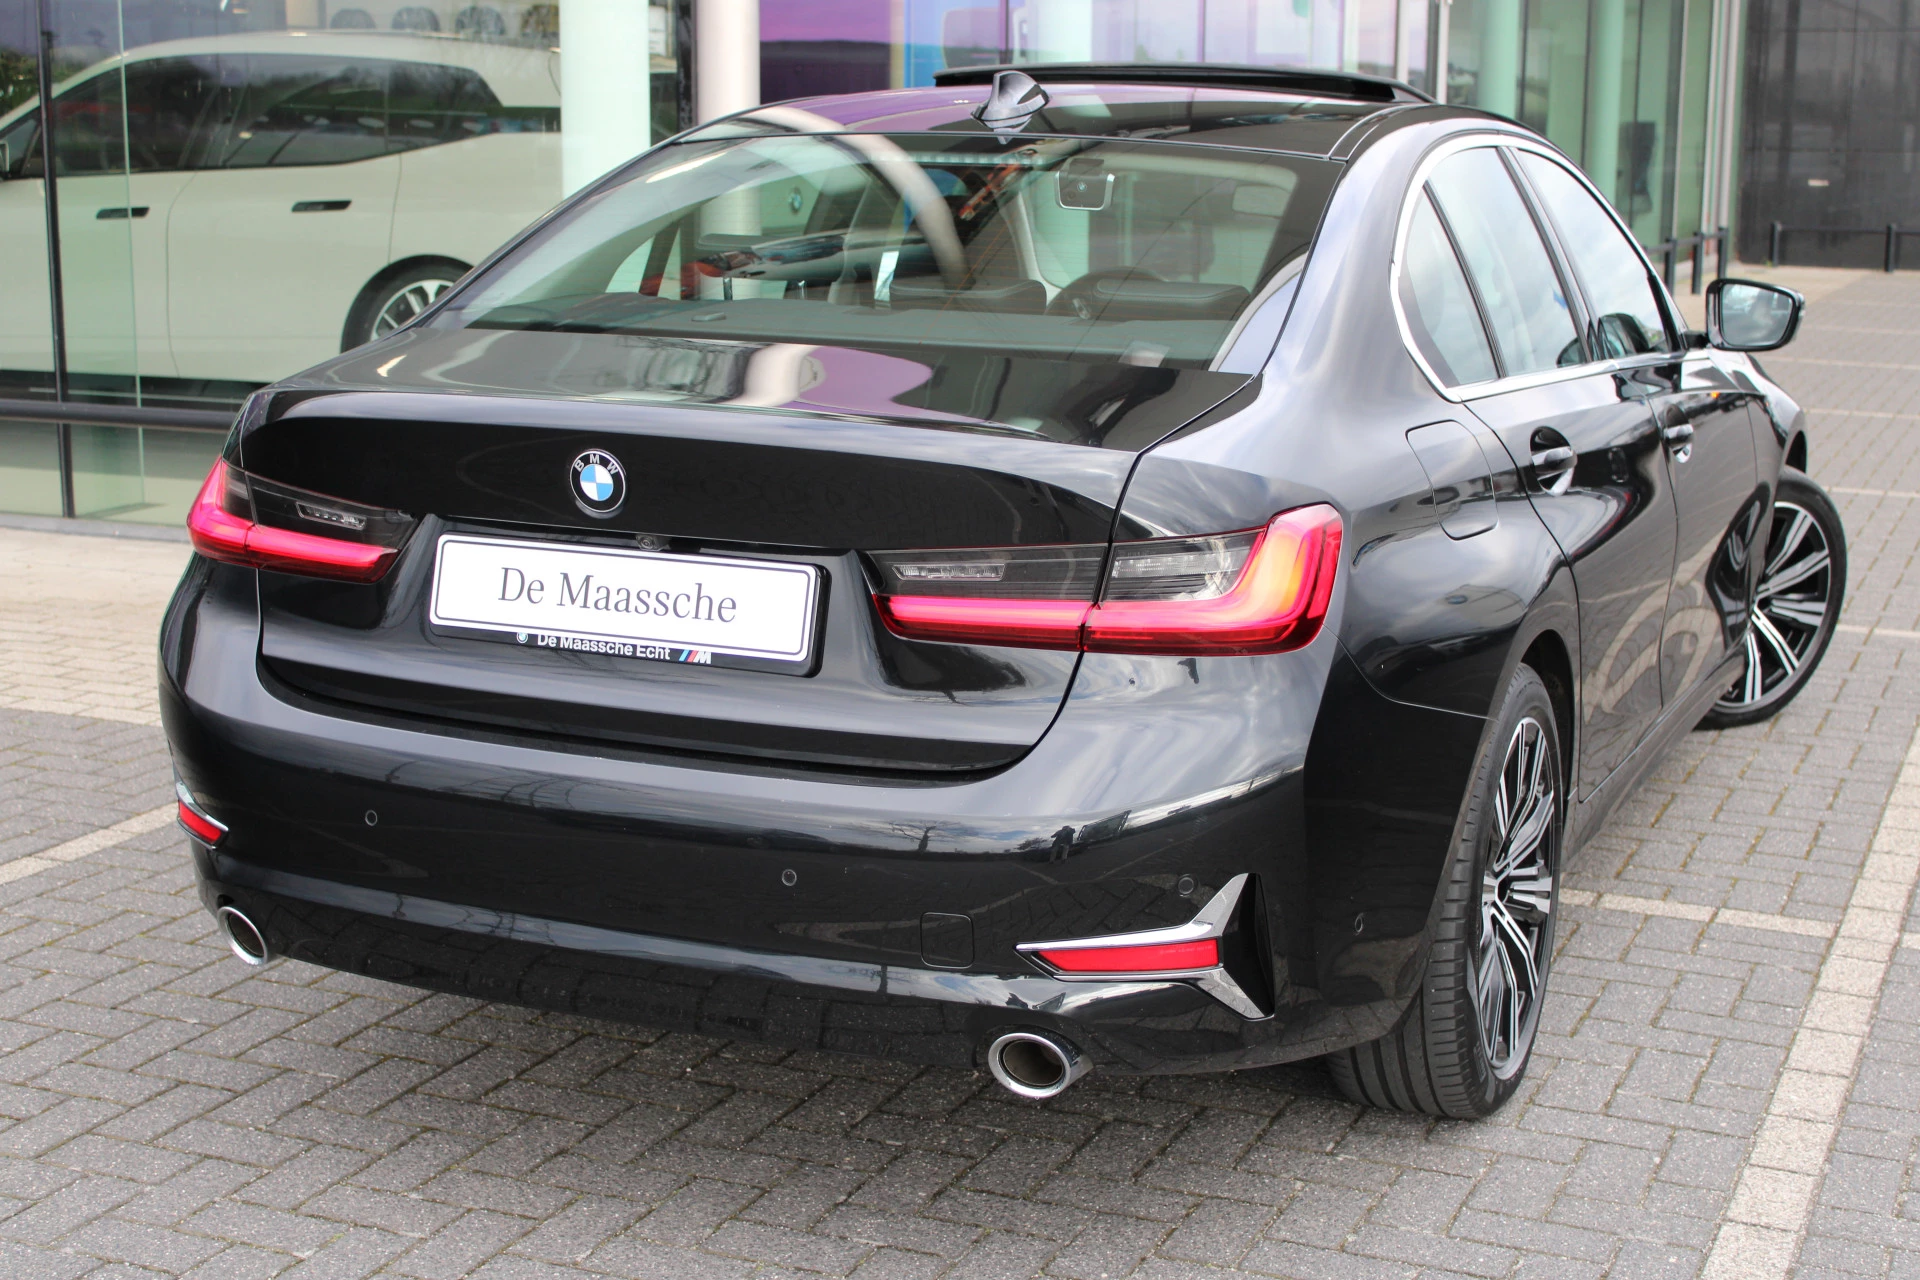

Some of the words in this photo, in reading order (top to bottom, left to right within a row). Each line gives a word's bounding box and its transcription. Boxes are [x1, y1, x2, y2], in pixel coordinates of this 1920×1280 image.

[573, 453, 619, 475] BMW
[497, 566, 545, 604] De
[555, 571, 737, 623] Maassche
[537, 633, 557, 648] De
[560, 636, 633, 656] Maassche
[635, 643, 671, 660] Echt
